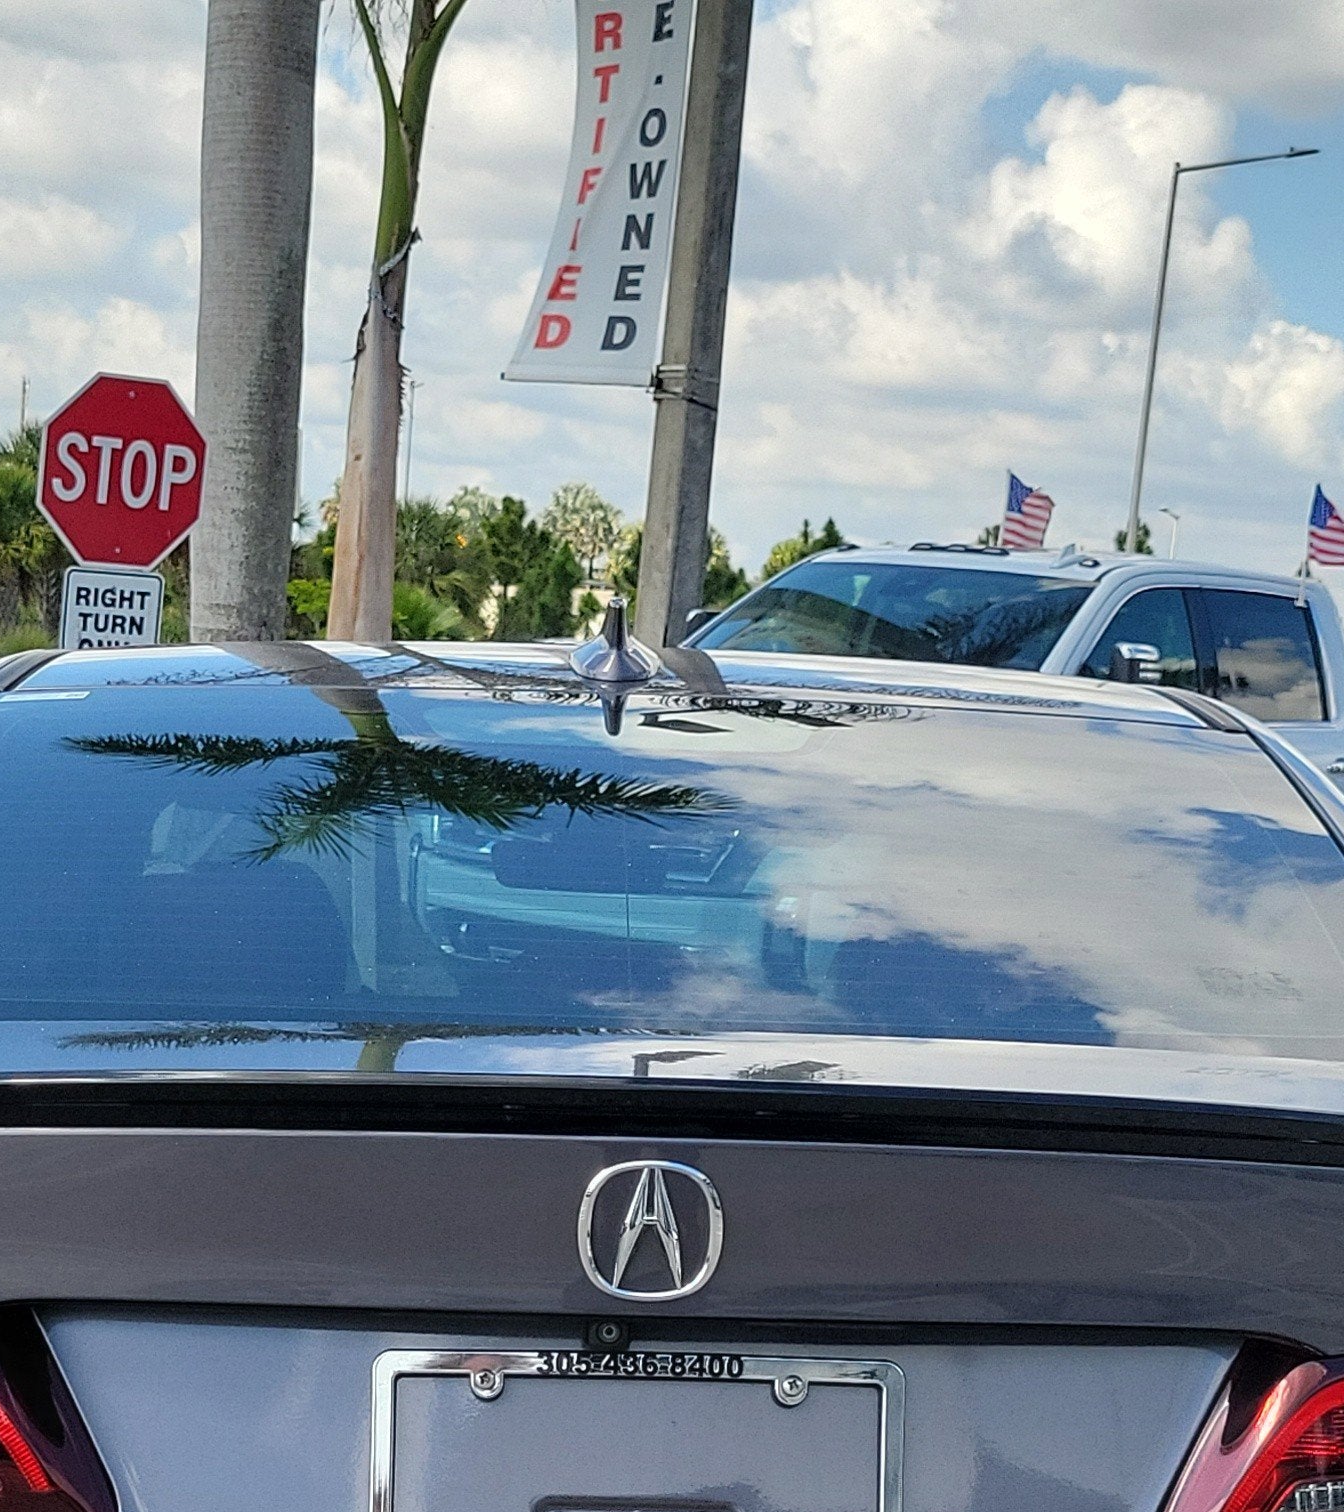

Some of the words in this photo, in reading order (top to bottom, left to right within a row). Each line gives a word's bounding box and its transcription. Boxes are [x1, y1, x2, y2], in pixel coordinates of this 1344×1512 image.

[51, 431, 197, 511] STOP
[75, 586, 151, 610] RIGHT
[78, 612, 145, 635] TURN
[536, 1353, 744, 1378] 305-436-8400
